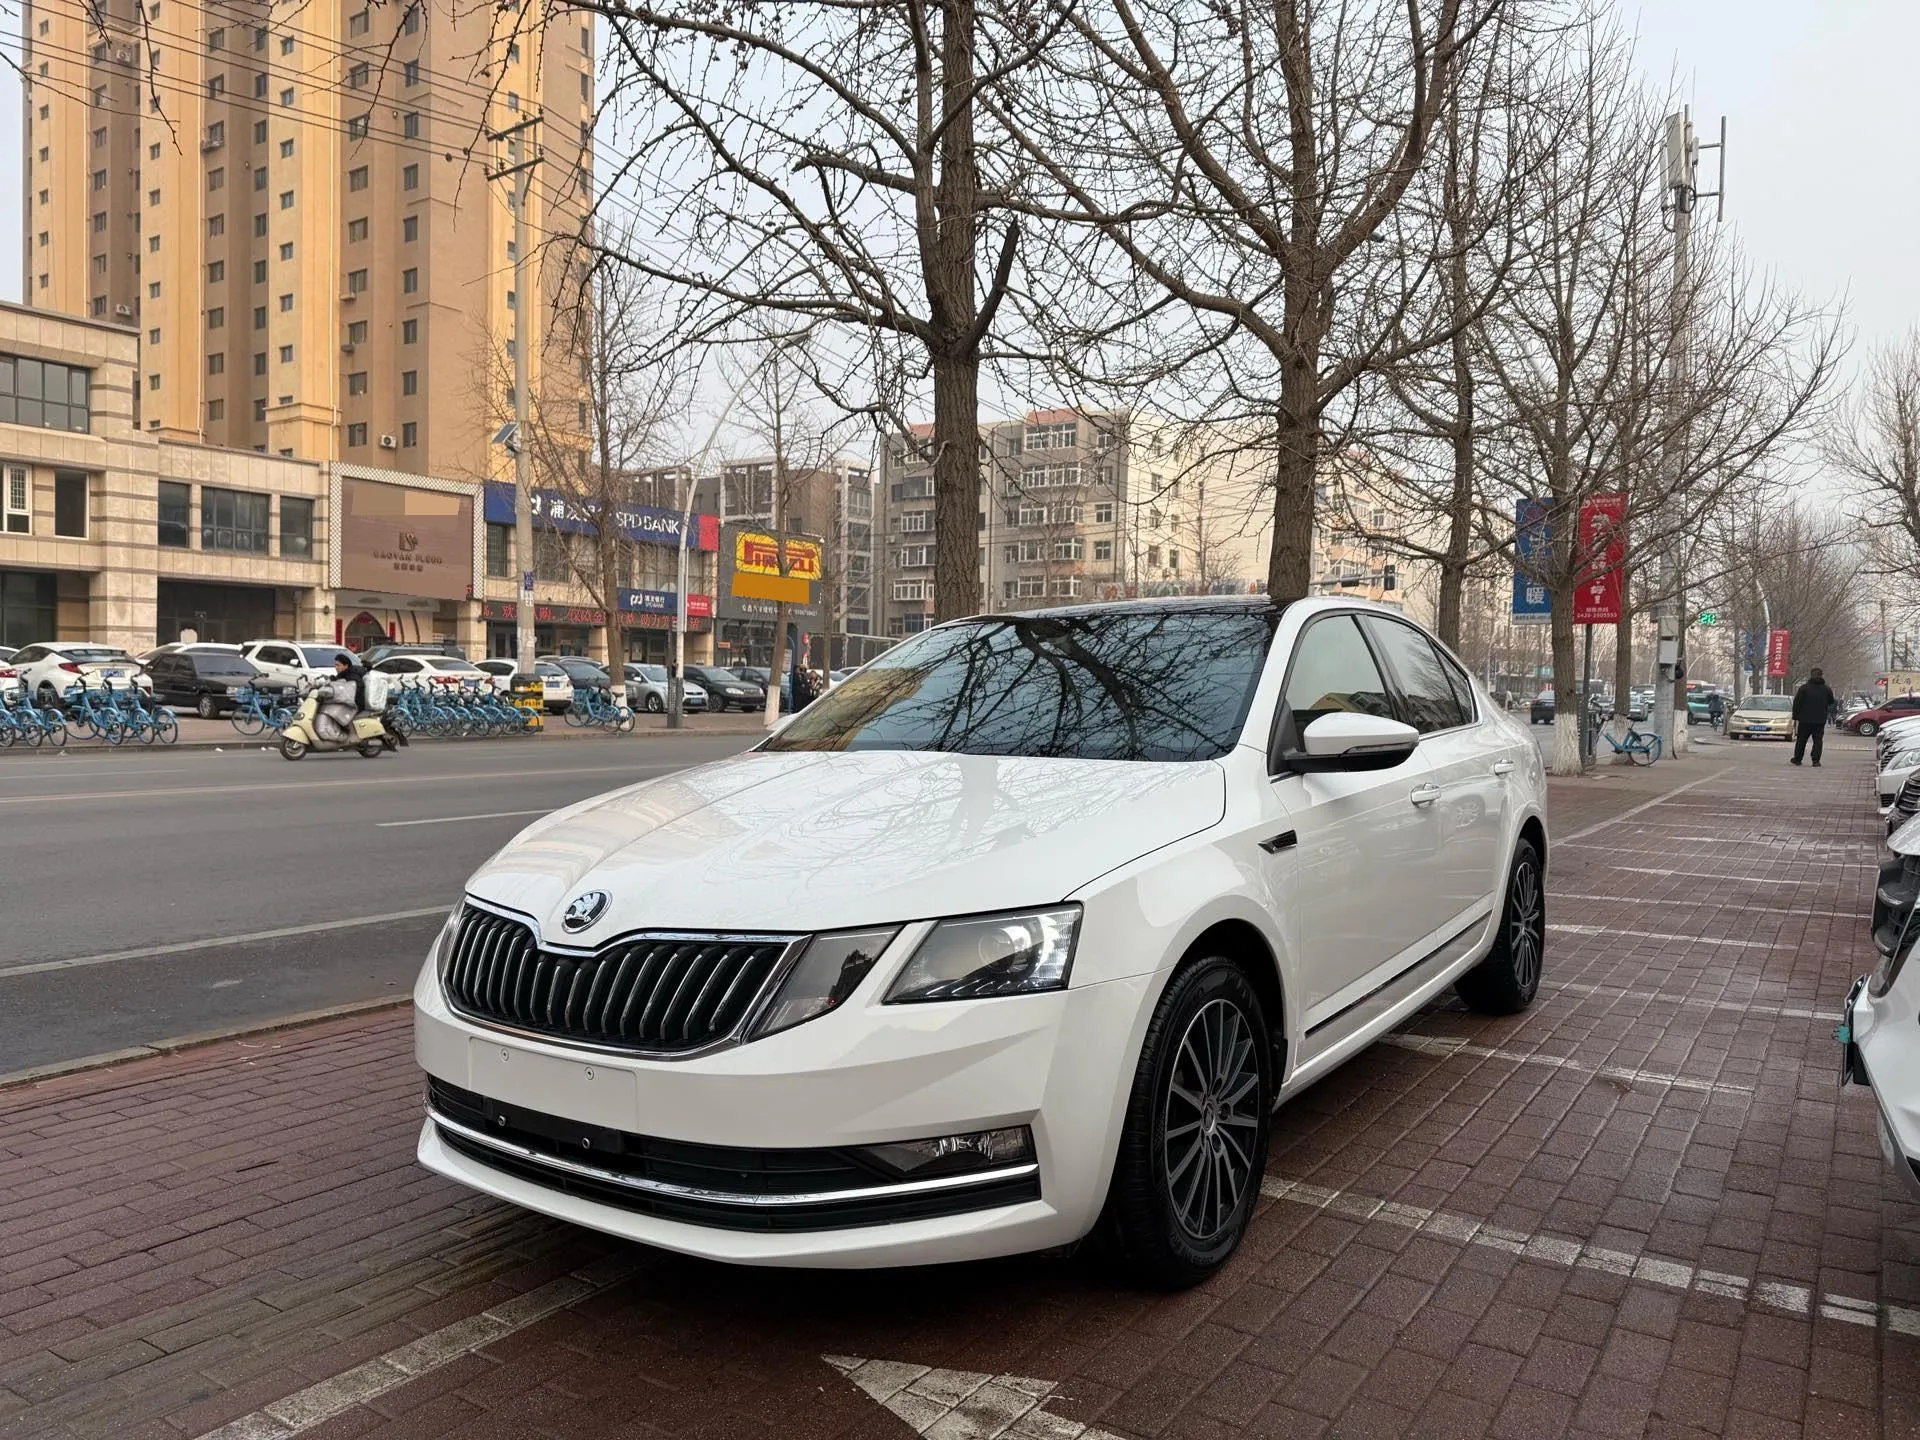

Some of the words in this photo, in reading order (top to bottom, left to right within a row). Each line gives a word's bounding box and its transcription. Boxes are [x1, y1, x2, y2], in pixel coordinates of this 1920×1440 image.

[616, 511, 642, 529] SPD
[643, 515, 680, 535] BANK
[743, 541, 815, 573] PIRLLI
